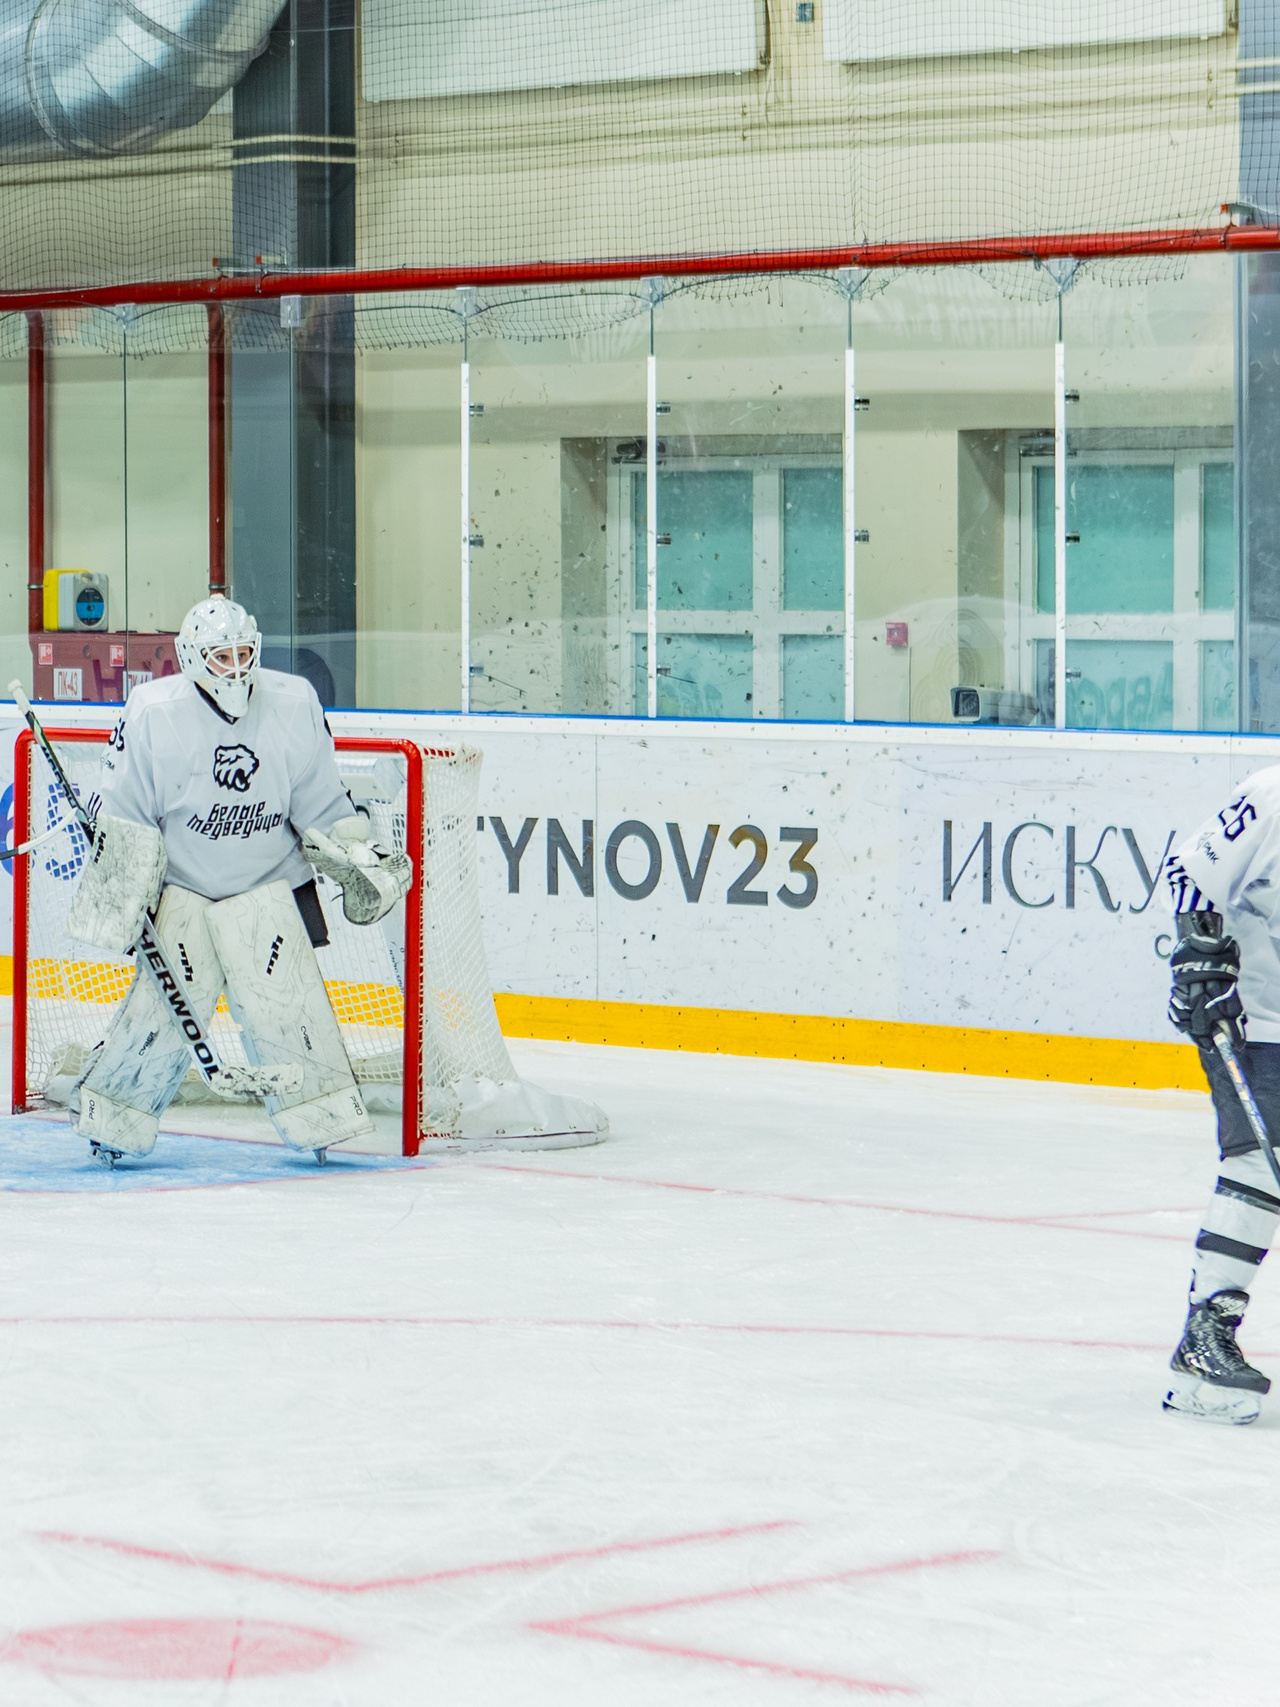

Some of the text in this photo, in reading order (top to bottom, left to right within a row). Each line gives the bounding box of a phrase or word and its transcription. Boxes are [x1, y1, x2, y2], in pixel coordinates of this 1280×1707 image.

[477, 815, 819, 911] YNOV23
[140, 928, 220, 1081] HERWOO
[88, 1099, 96, 1120] PRO
[350, 1095, 364, 1116] PRO
